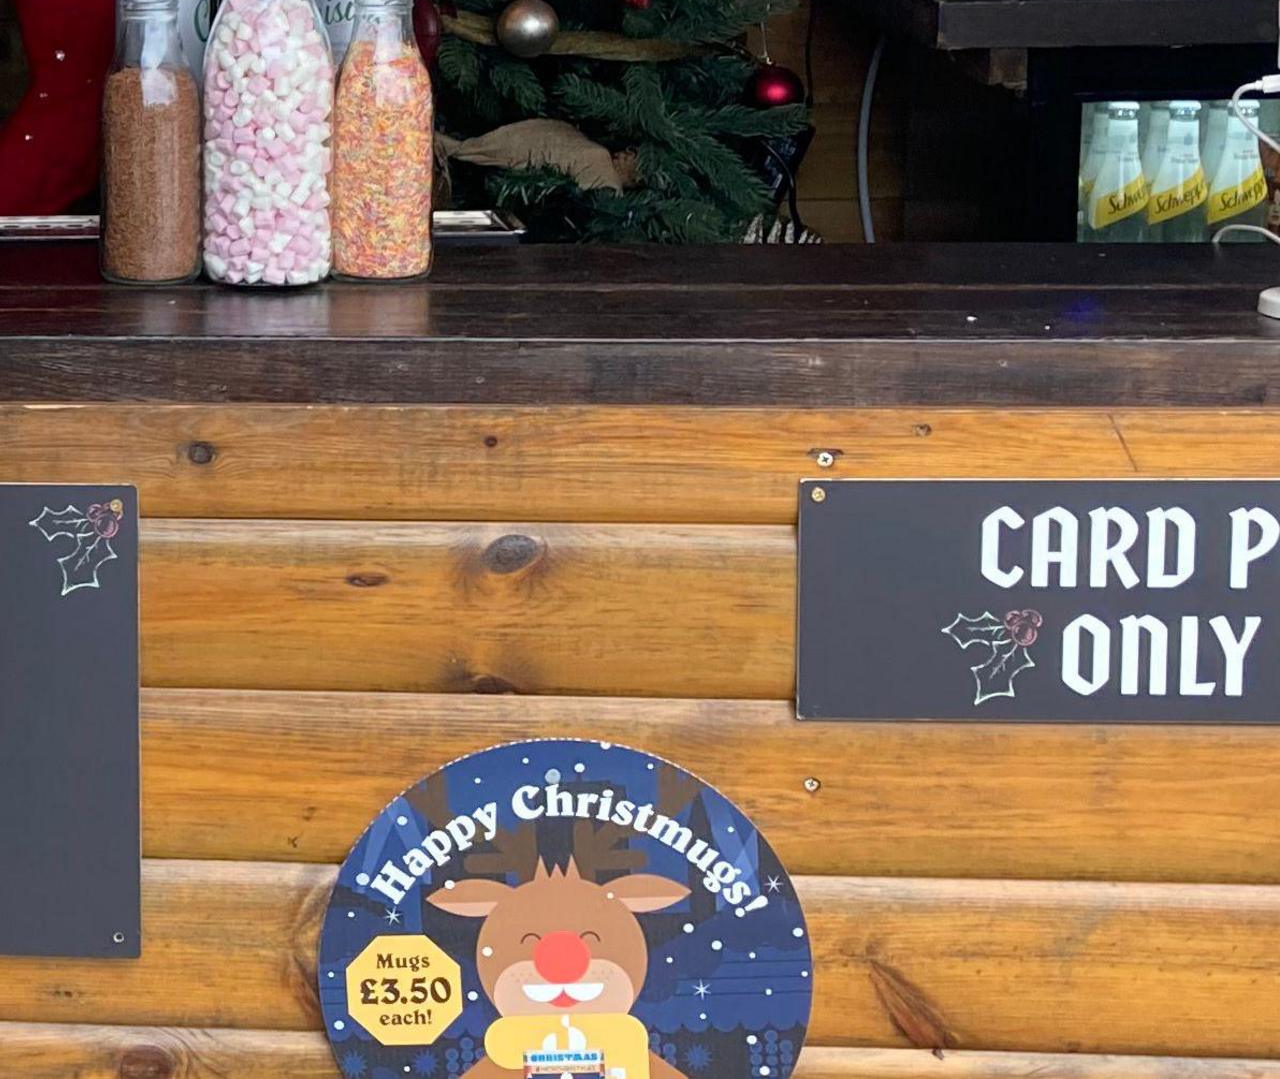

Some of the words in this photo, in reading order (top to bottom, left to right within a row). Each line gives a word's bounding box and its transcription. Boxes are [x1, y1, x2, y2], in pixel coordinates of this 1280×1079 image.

[980, 505, 1197, 590] CARD
[1060, 613, 1263, 697] ONLY
[370, 801, 498, 906] Happy
[511, 783, 770, 918] Christmugs!
[375, 953, 430, 972] Mugs
[359, 977, 452, 1005] £3.50
[379, 1009, 433, 1027] each!
